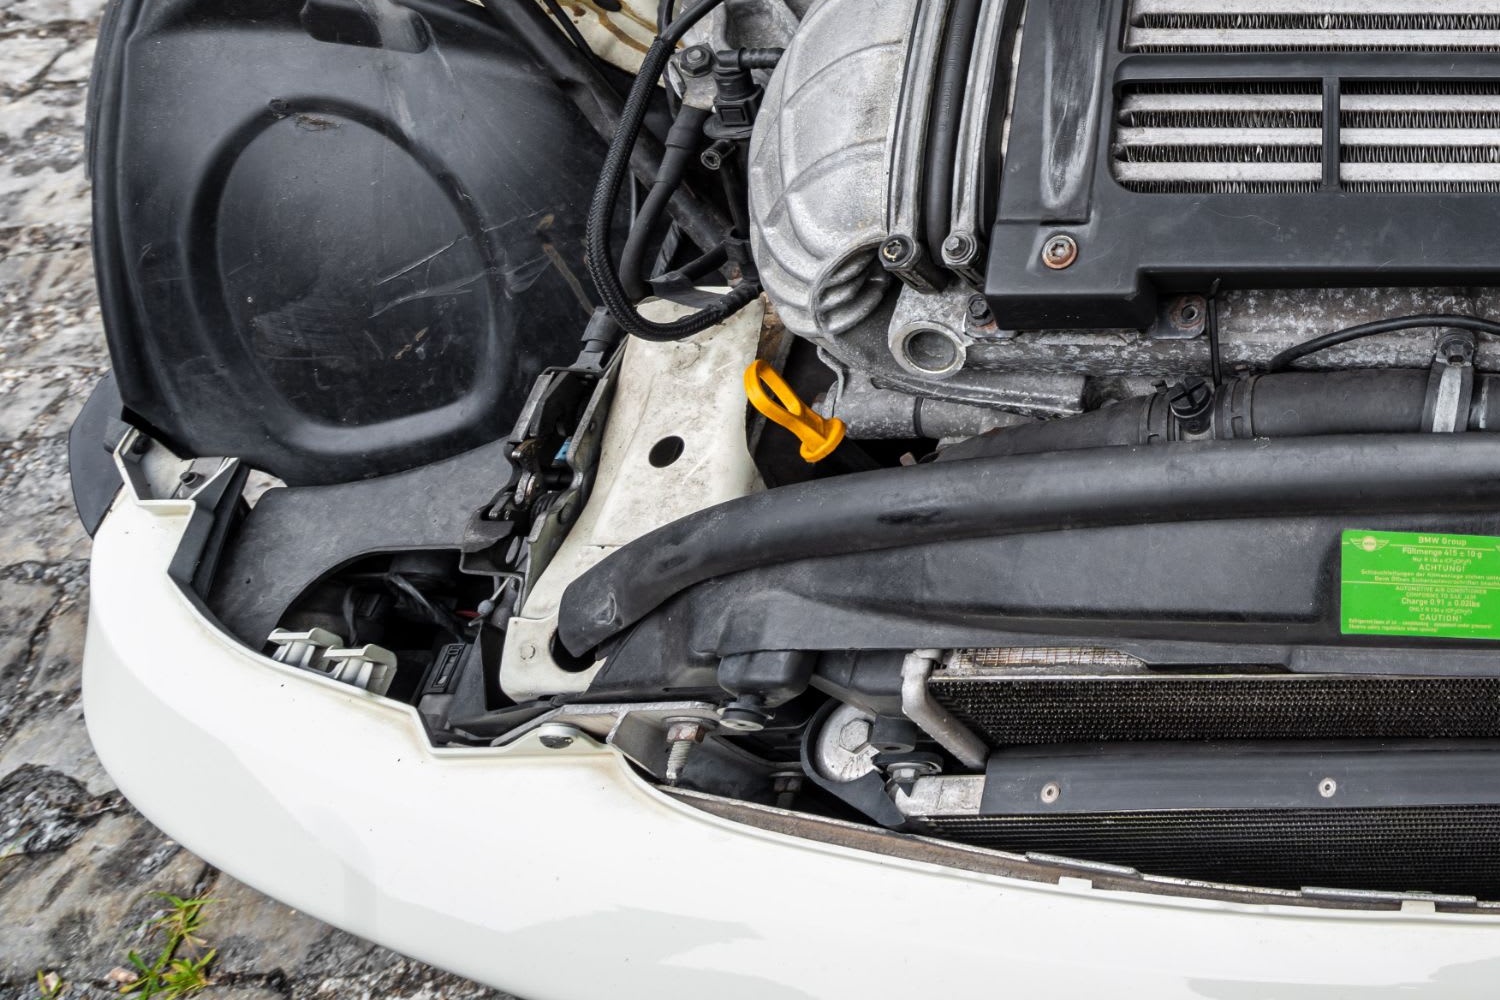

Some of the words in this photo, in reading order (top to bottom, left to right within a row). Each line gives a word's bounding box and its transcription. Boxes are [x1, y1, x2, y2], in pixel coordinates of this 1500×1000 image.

[1418, 536, 1440, 544] BMW
[1441, 537, 1467, 546] Group
[1418, 563, 1465, 573] ACHTUNG!
[1401, 597, 1428, 606] Charge
[1419, 613, 1462, 622] CAUTION!
